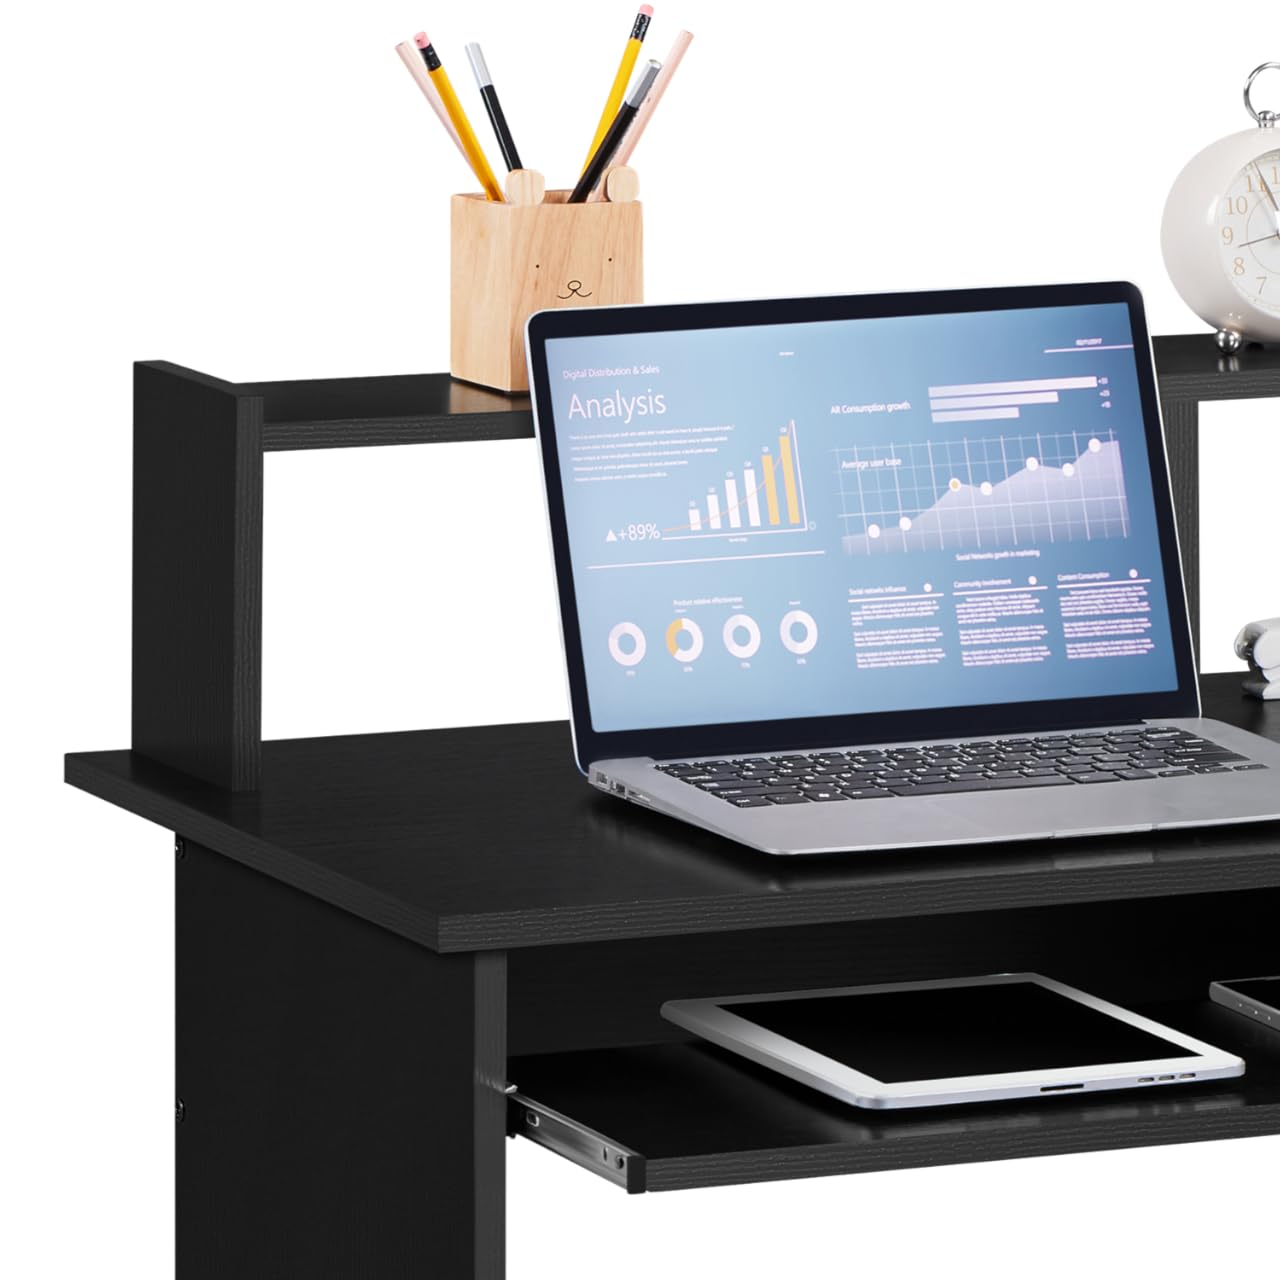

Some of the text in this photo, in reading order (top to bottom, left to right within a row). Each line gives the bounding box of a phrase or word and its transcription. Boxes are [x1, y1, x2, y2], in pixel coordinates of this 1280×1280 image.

[1226, 196, 1248, 215] 10
[1221, 226, 1233, 245] 9
[1233, 257, 1245, 276] 8
[1255, 276, 1267, 295] 7
[562, 368, 587, 381] Digital
[588, 366, 631, 378] Distribution
[639, 363, 660, 374] Sales
[568, 388, 667, 424] Analysis
[618, 522, 661, 540] +89%
